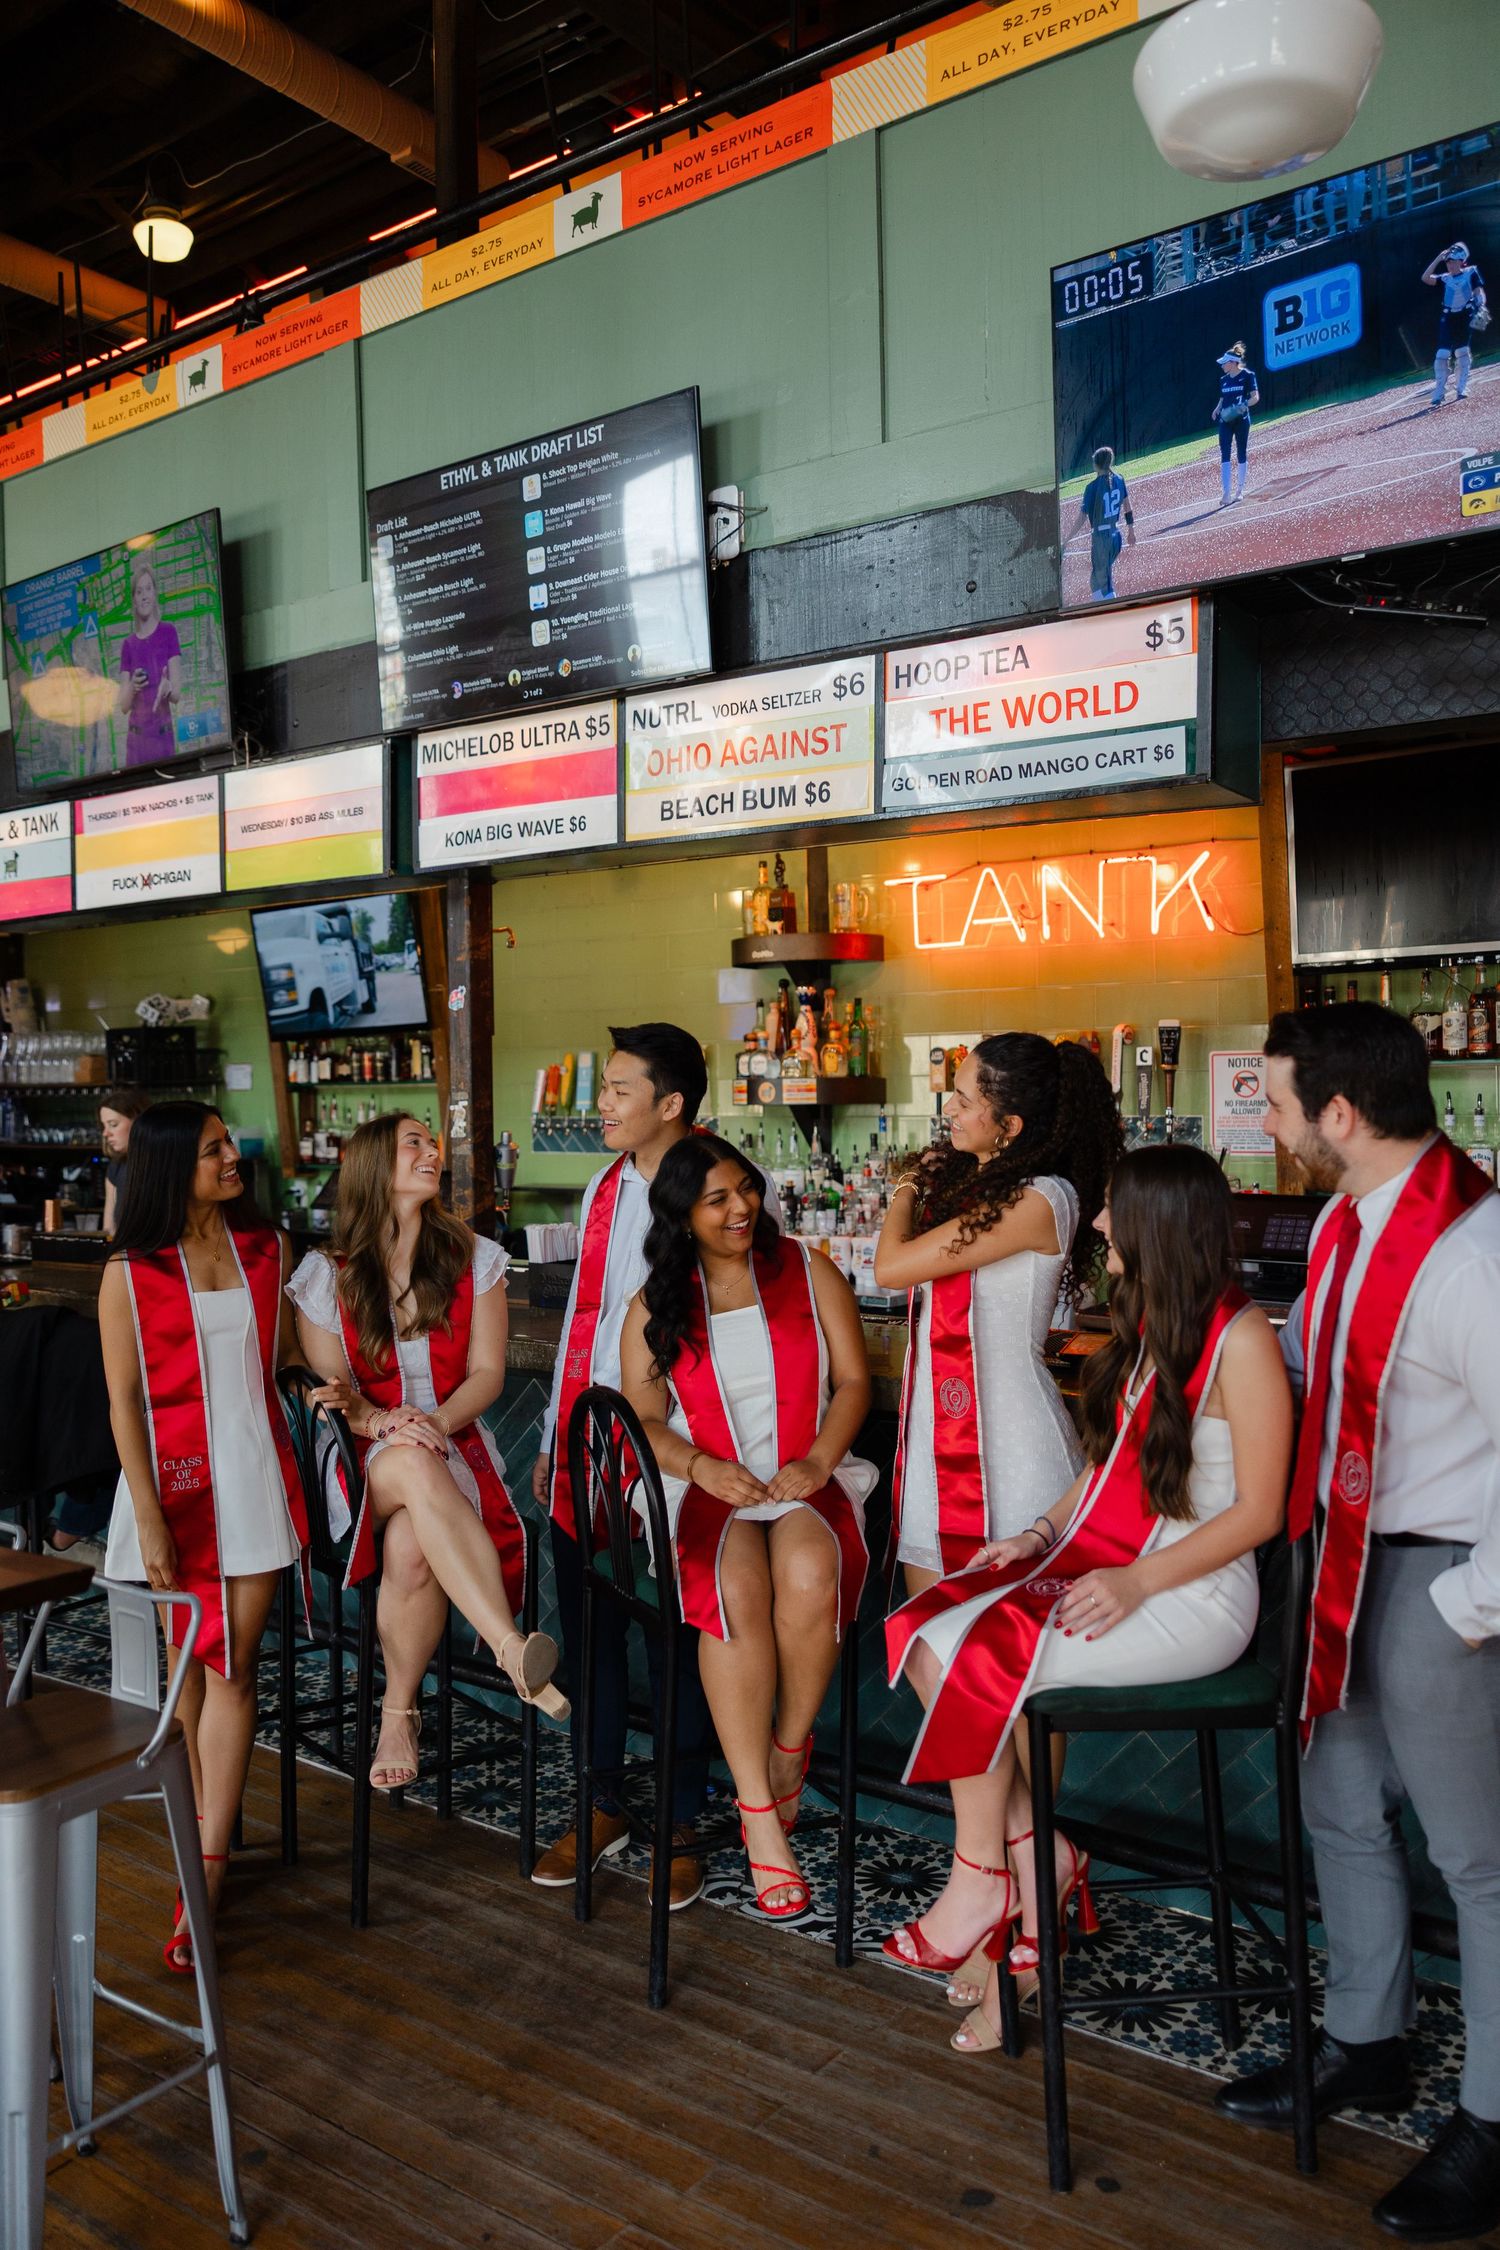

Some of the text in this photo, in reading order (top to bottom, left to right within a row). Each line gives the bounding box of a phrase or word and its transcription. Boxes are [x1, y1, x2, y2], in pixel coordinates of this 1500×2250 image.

[1003, 4, 1052, 32] $2.75
[940, 0, 1120, 82] ALL DAY, EVERYDAY
[673, 121, 774, 173] NOW SERVING
[638, 127, 814, 207] SYCAMORE LIGHT LAGER
[472, 237, 503, 258] $2.75
[431, 238, 544, 293] ALL DAY, EVERYDAY
[1064, 261, 1143, 314] 00:05
[255, 314, 323, 348] NOW SERVING
[1275, 320, 1351, 357] NETWORK
[232, 320, 349, 374] SYCAMORE LIGHT LAGER
[119, 389, 141, 405] $2.75
[92, 393, 171, 431] ALL DAY, EVERYDAY
[11, 449, 36, 464] LAGER
[441, 424, 604, 490] ETHYL & TANK DRAFT LIST
[548, 466, 566, 479] Shock
[567, 463, 577, 475] Top
[578, 456, 600, 472] Belgian
[601, 450, 618, 464] White
[1467, 456, 1494, 469] VOLPE
[549, 504, 564, 515] Kona
[565, 498, 584, 511] Hawaii
[585, 495, 595, 507] Big
[595, 490, 611, 503] Wave
[1103, 489, 1120, 518] 12
[377, 516, 408, 534] Draft List
[398, 521, 439, 540] Anheuser-Busch
[439, 514, 463, 529] Michelob
[463, 509, 480, 522] ULTRA
[552, 541, 570, 553] Grupo
[571, 534, 593, 547] Modelo
[594, 528, 616, 541] Modelo
[401, 552, 441, 571] Anheuser-Busch
[441, 545, 467, 561] Sycamore
[467, 541, 481, 554] Light
[25, 564, 85, 594] ORANGE BARREL
[403, 584, 443, 601] Anheuser-Busch
[443, 580, 459, 591] Busch
[460, 576, 474, 588] Light
[554, 574, 582, 589] Downeast
[583, 570, 599, 581] Cider
[600, 565, 619, 578] House
[405, 621, 424, 632] Hi-Wire
[424, 616, 442, 629] Mango
[559, 610, 588, 626] Yuengling
[588, 603, 620, 618] Traditional
[407, 650, 432, 662] Columbus
[432, 647, 445, 657] Ohio
[445, 644, 459, 655] Light
[894, 616, 1185, 690] HOOP TEA $5
[532, 688, 538, 696] of
[632, 672, 865, 731] NUTRL VODKA SELTZER $6
[929, 680, 1139, 739] THE WORLD
[422, 714, 610, 764] MICHELOB ULTRA $5
[647, 723, 848, 777] OHIO AGAINST
[892, 743, 1174, 792] GOLDEN ROAD MANGO CART $6
[131, 806, 148, 815] TANK
[149, 799, 178, 811] NACHOS
[185, 796, 194, 805] $5
[195, 792, 214, 802] TANK
[661, 780, 831, 821] BEACH BUM $6
[8, 811, 59, 839] & TANK
[290, 817, 304, 826] $10
[305, 814, 316, 823] BIG
[318, 811, 334, 820] ASS
[337, 806, 364, 818] MULES
[445, 816, 587, 847] KONA BIG WAVE $6
[112, 876, 139, 890] FUCK
[883, 850, 1216, 950] TANK
[1140, 1049, 1148, 1062] C
[1228, 1057, 1263, 1068] NOTICE
[567, 1348, 588, 1358] CLASS
[163, 1456, 203, 1470] CLASS
[176, 1469, 192, 1480] OF
[170, 1478, 200, 1492] 2025
